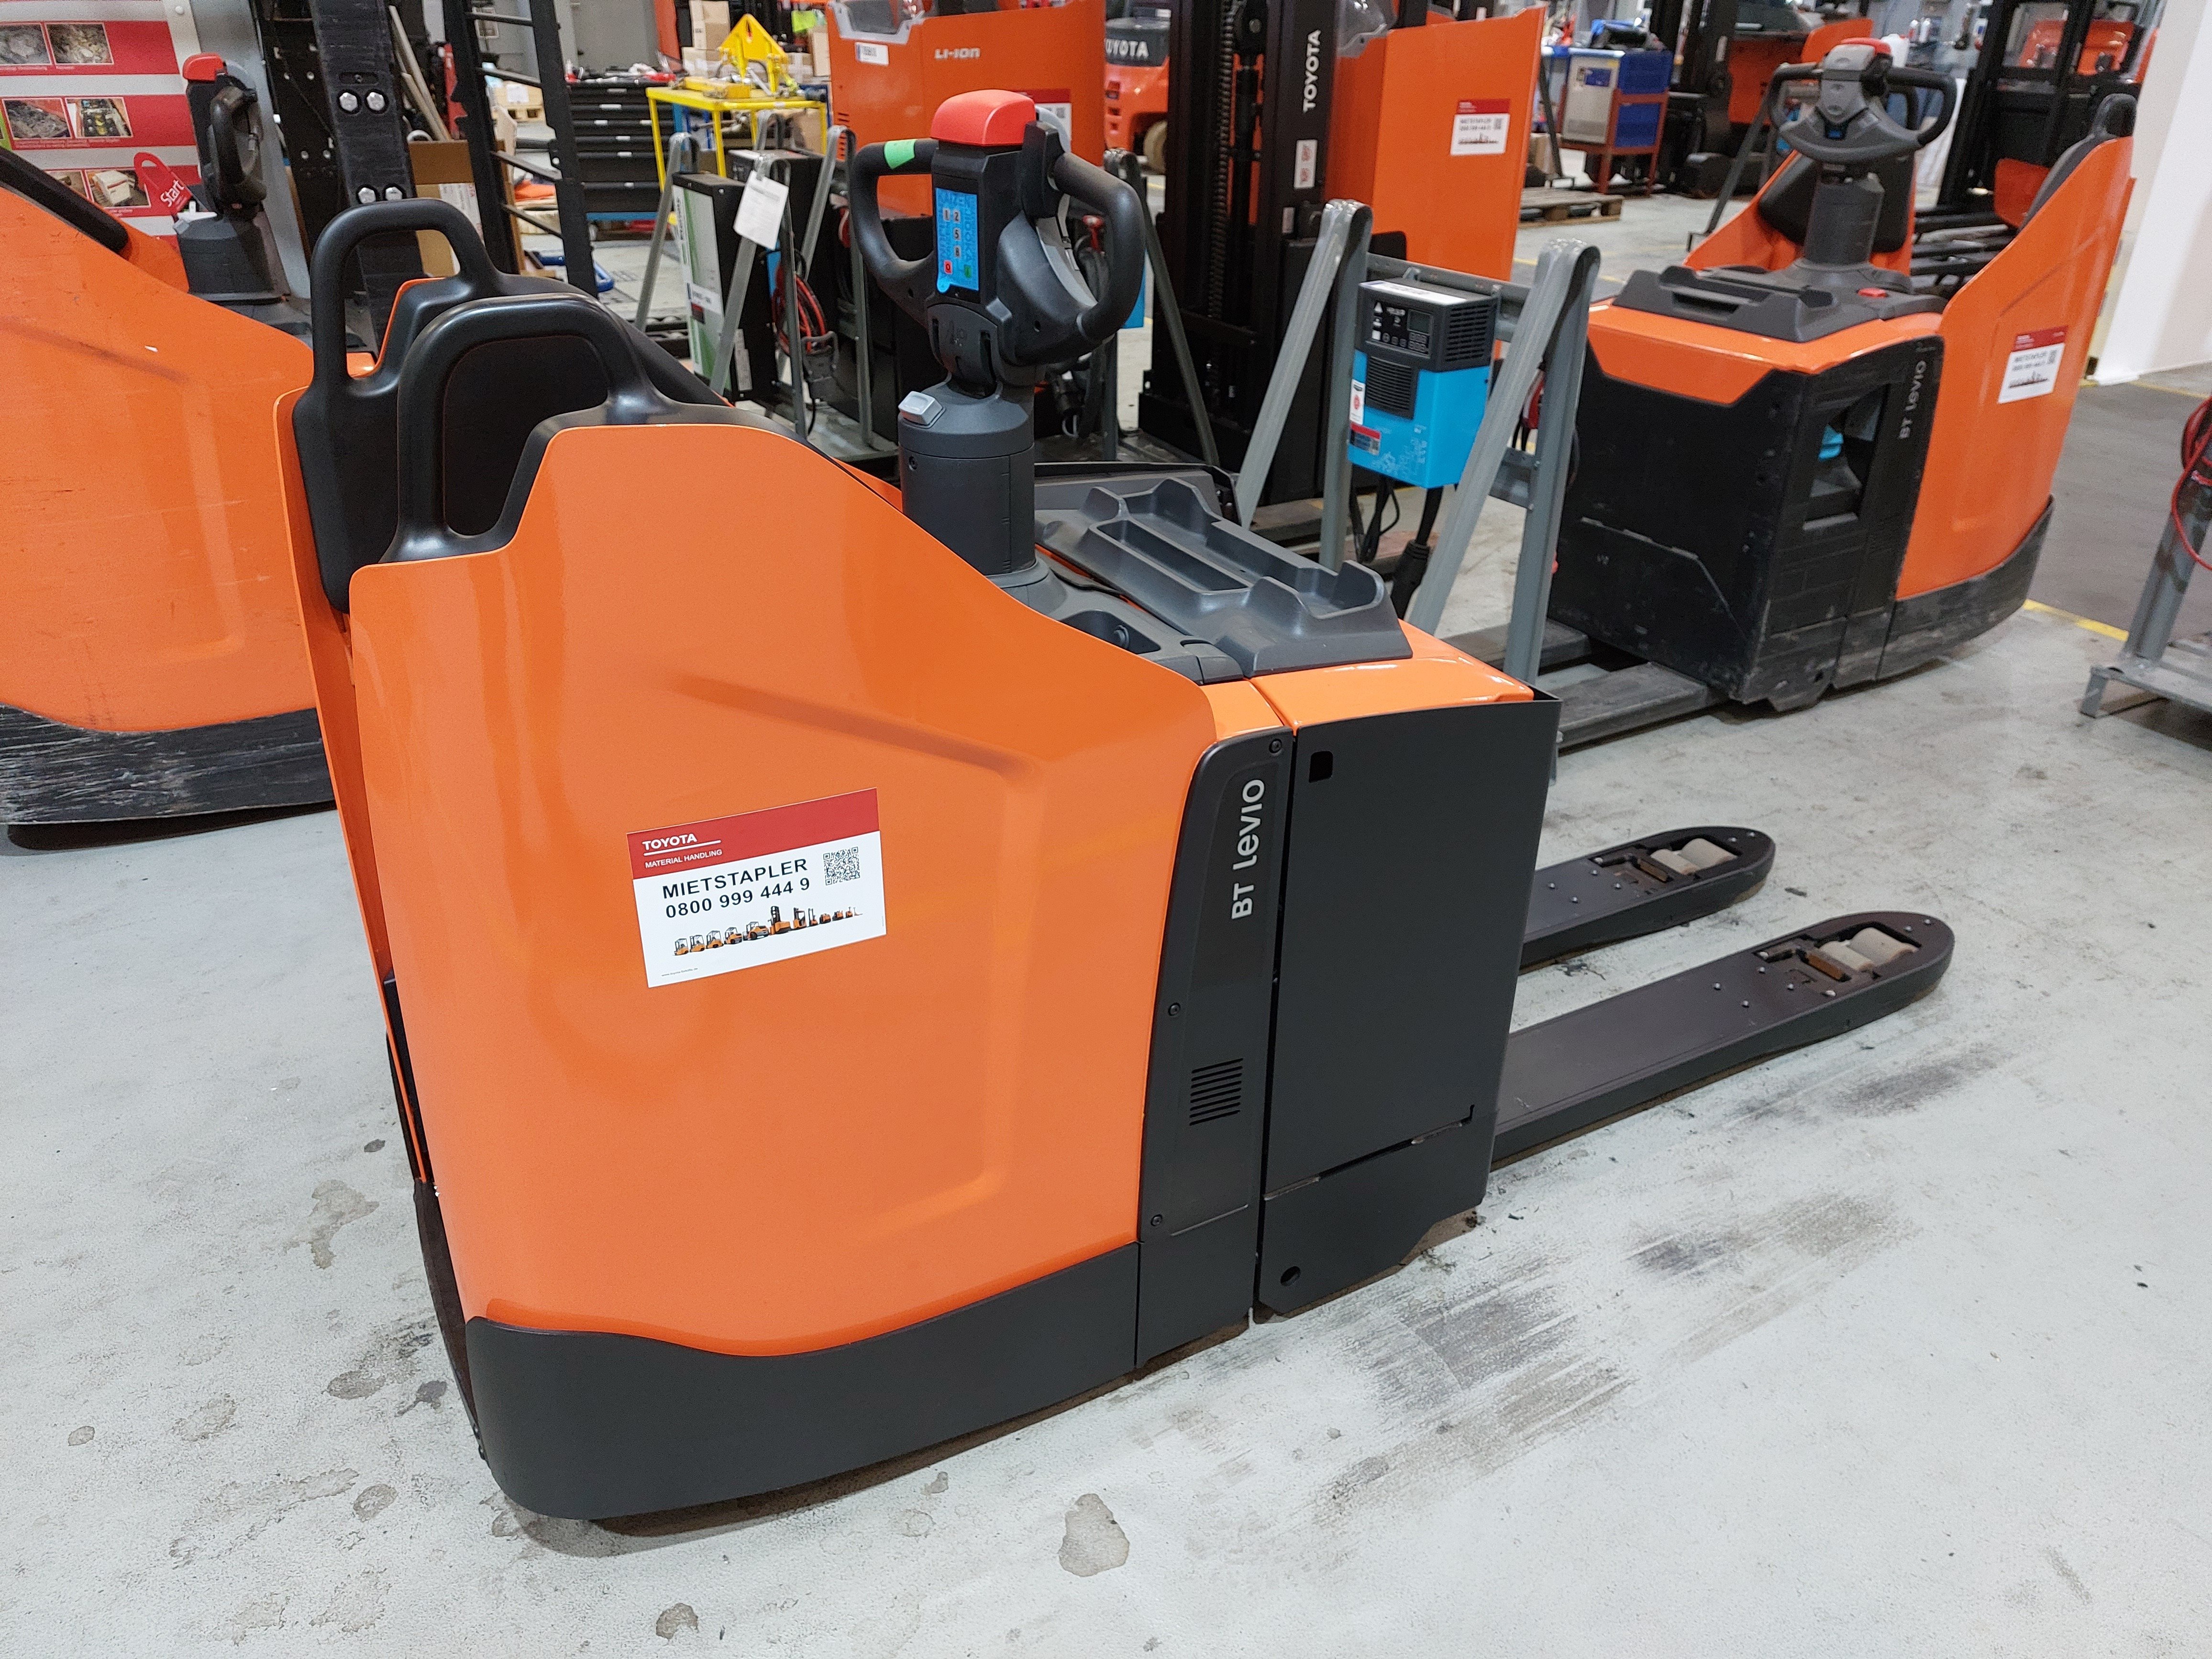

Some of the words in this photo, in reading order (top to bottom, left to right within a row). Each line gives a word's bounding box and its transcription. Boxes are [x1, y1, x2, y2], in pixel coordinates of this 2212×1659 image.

[1106, 38, 1149, 58] OYOTA
[1302, 29, 1322, 113] TOYOTA
[160, 179, 185, 207] Start
[954, 211, 959, 221] 2
[954, 229, 959, 239] 5
[642, 833, 697, 851] TOYOTA
[645, 856, 683, 868] MATERIAL
[684, 849, 722, 862] HANDLING
[663, 858, 808, 899] MIETSTAPLER
[665, 898, 712, 918] 0800
[719, 890, 753, 908] 999
[760, 881, 794, 898] 444
[799, 877, 810, 890] 9
[1231, 883, 1254, 919] BT
